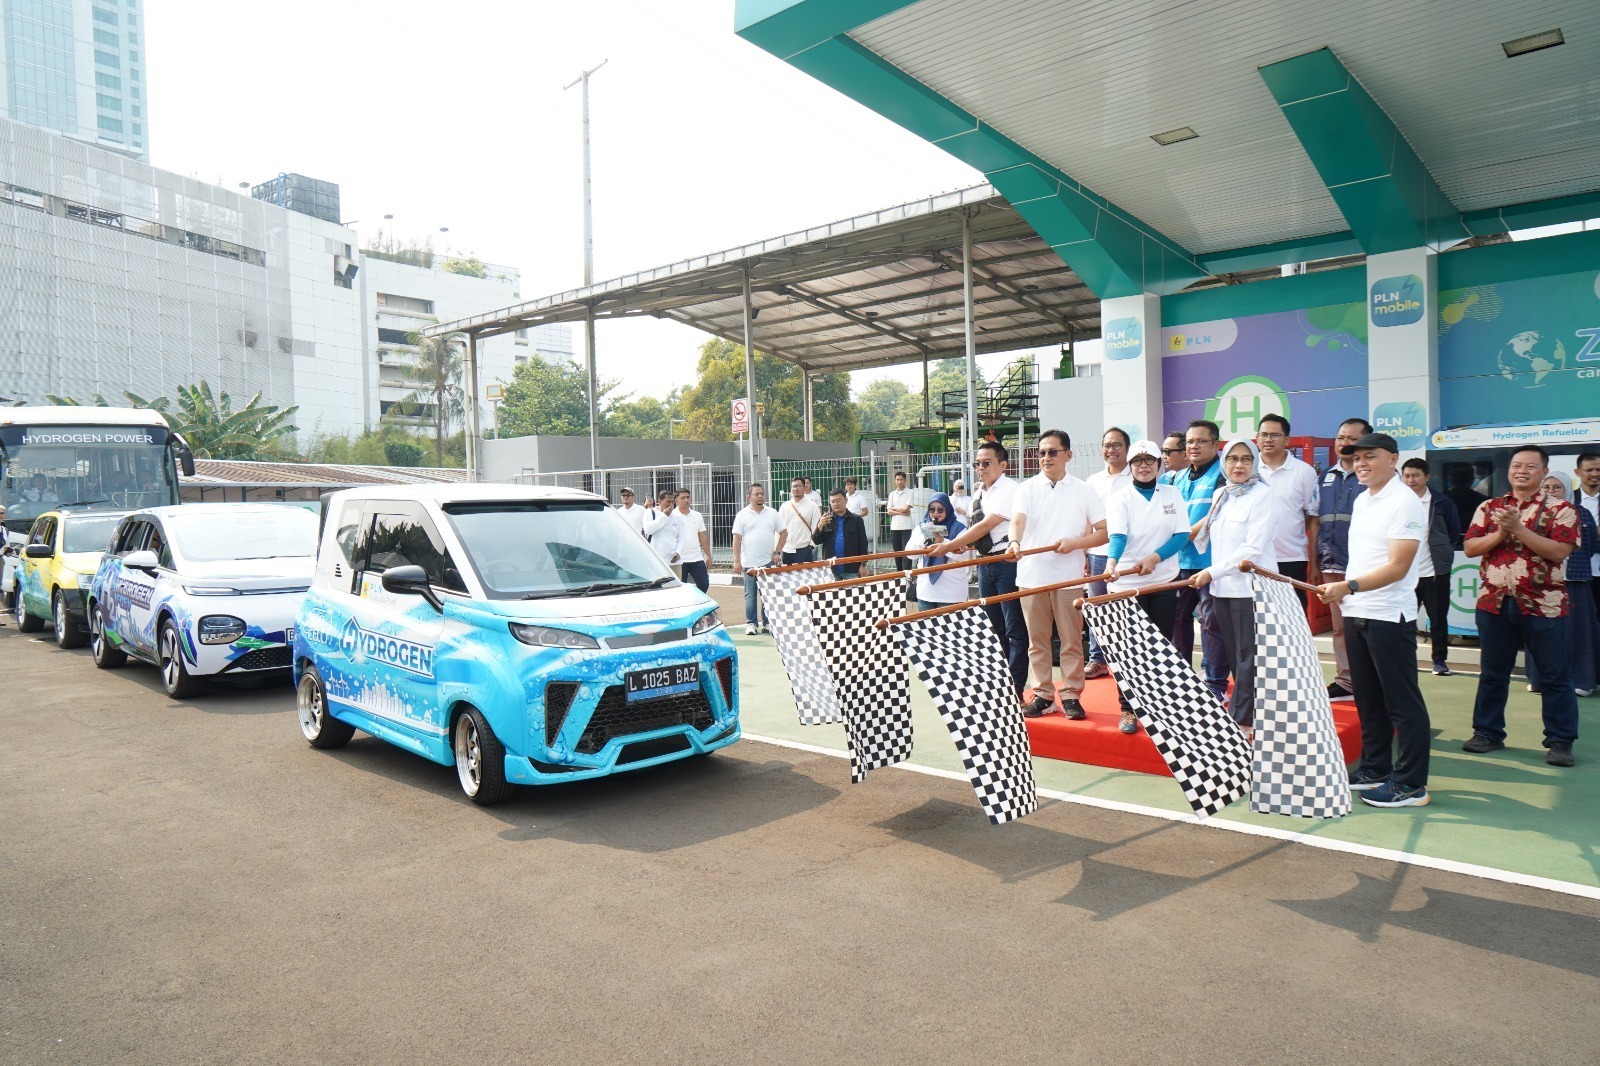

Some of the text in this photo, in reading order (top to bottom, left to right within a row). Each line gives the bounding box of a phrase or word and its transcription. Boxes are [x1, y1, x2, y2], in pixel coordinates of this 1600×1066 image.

[1374, 291, 1400, 304] PLN
[1374, 300, 1421, 315] mobile
[1106, 331, 1126, 341] PLN
[1186, 335, 1212, 346] PLN
[1106, 338, 1141, 350] mobile
[1376, 416, 1402, 427] PLN
[22, 434, 154, 444] HYDROGEN POWER
[1492, 428, 1589, 441] Hydrogen Refueller
[370, 582, 383, 594] PLN
[342, 620, 432, 674] HYDROGEN
[629, 666, 697, 691] L 1025 BAZ
